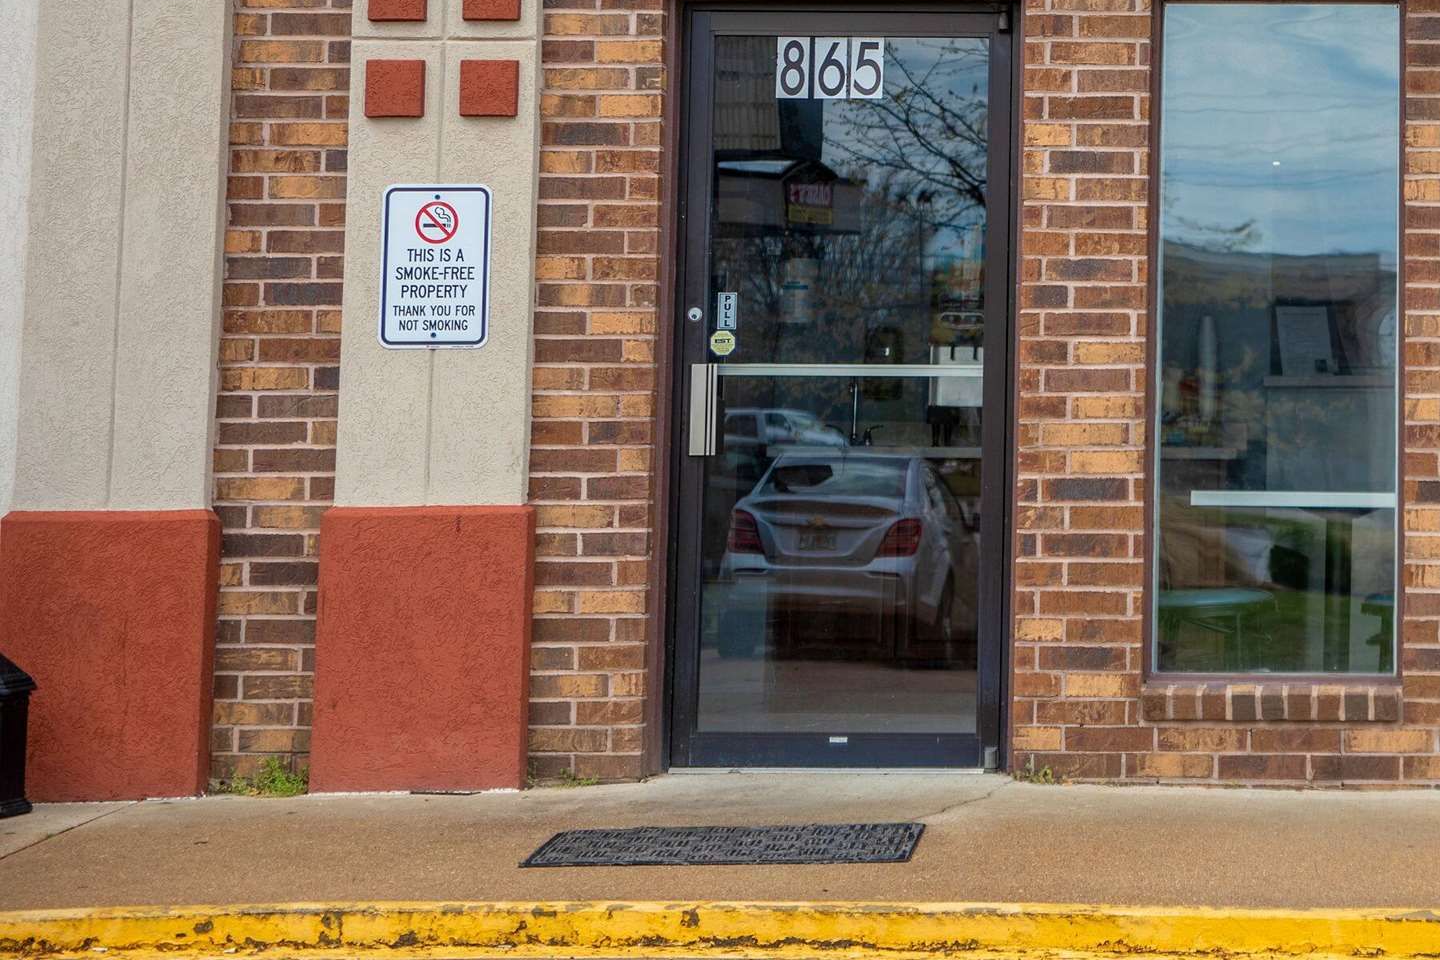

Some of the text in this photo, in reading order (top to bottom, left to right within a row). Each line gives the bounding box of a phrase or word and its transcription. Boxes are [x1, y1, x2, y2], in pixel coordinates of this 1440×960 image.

[407, 248, 465, 262] THIS IS A
[395, 266, 476, 281] SMOKE-FREE
[401, 284, 468, 299] PROPERTY
[392, 304, 476, 317] THANK YOU FOR
[724, 295, 732, 327] PULL
[398, 319, 469, 332] NOT SMOKING
